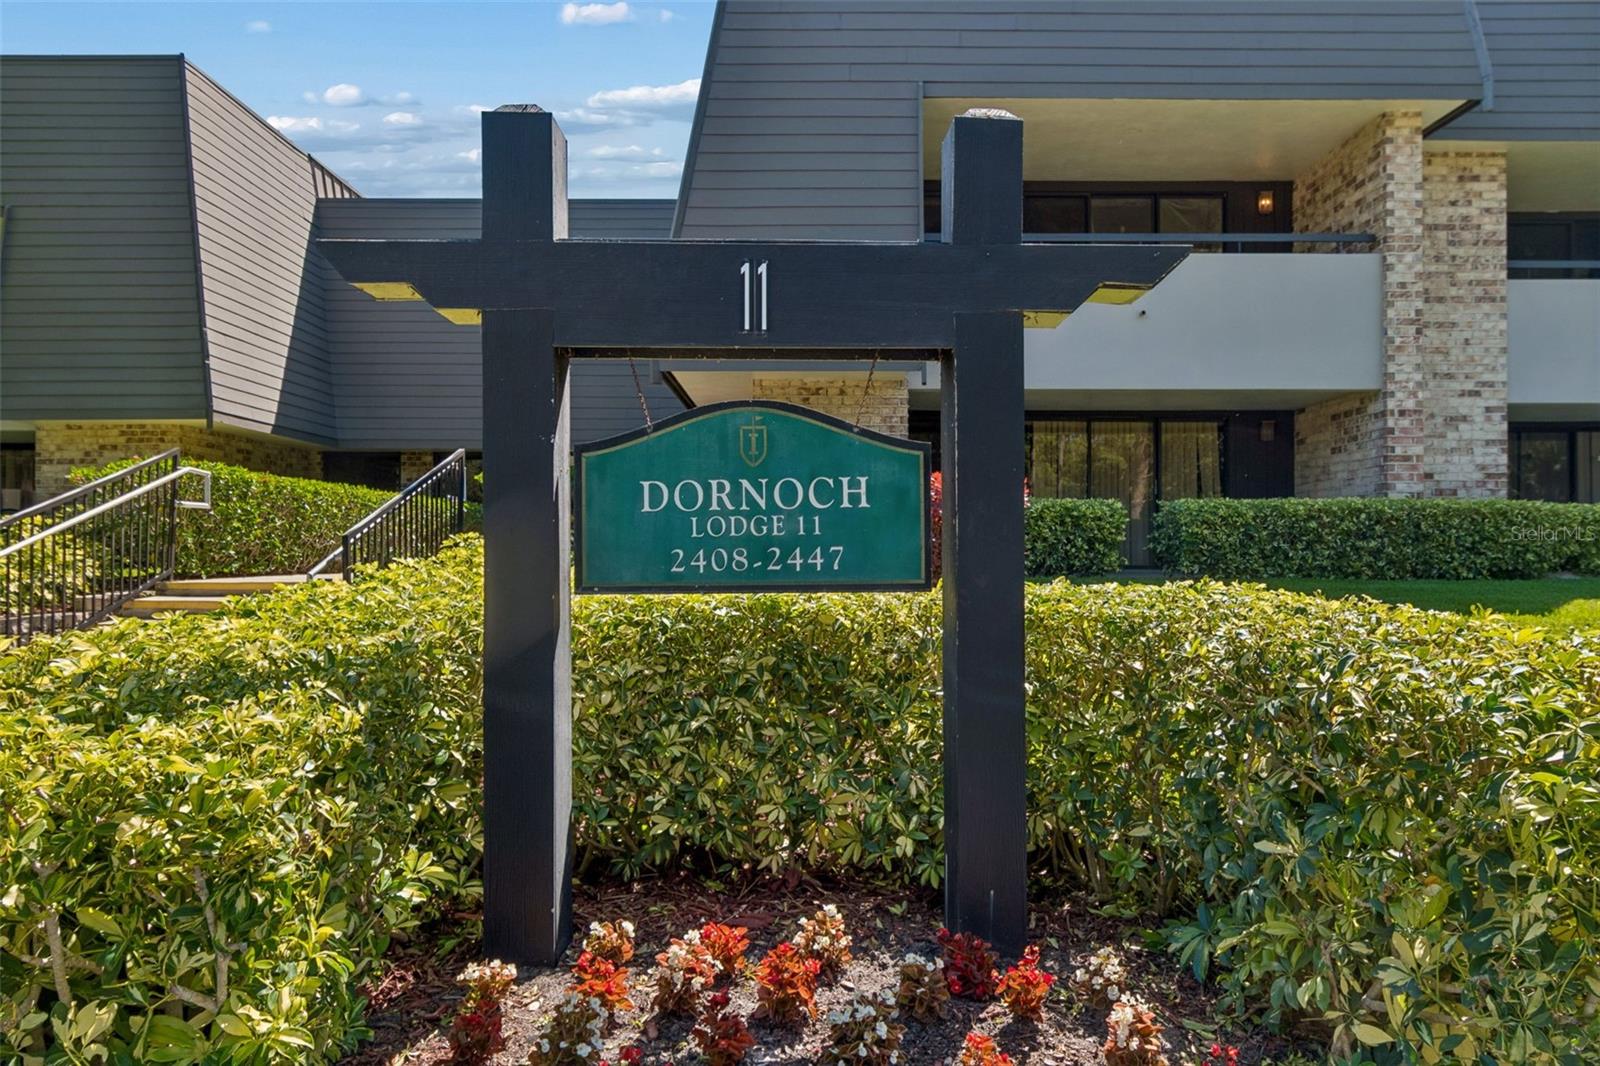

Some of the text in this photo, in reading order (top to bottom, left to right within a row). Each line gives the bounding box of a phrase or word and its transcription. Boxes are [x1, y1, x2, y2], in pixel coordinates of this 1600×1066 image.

[740, 262, 768, 330] 11
[639, 475, 871, 513] DORNOCH
[690, 514, 822, 538] LODGE 11
[670, 546, 844, 573] 2408-2447
